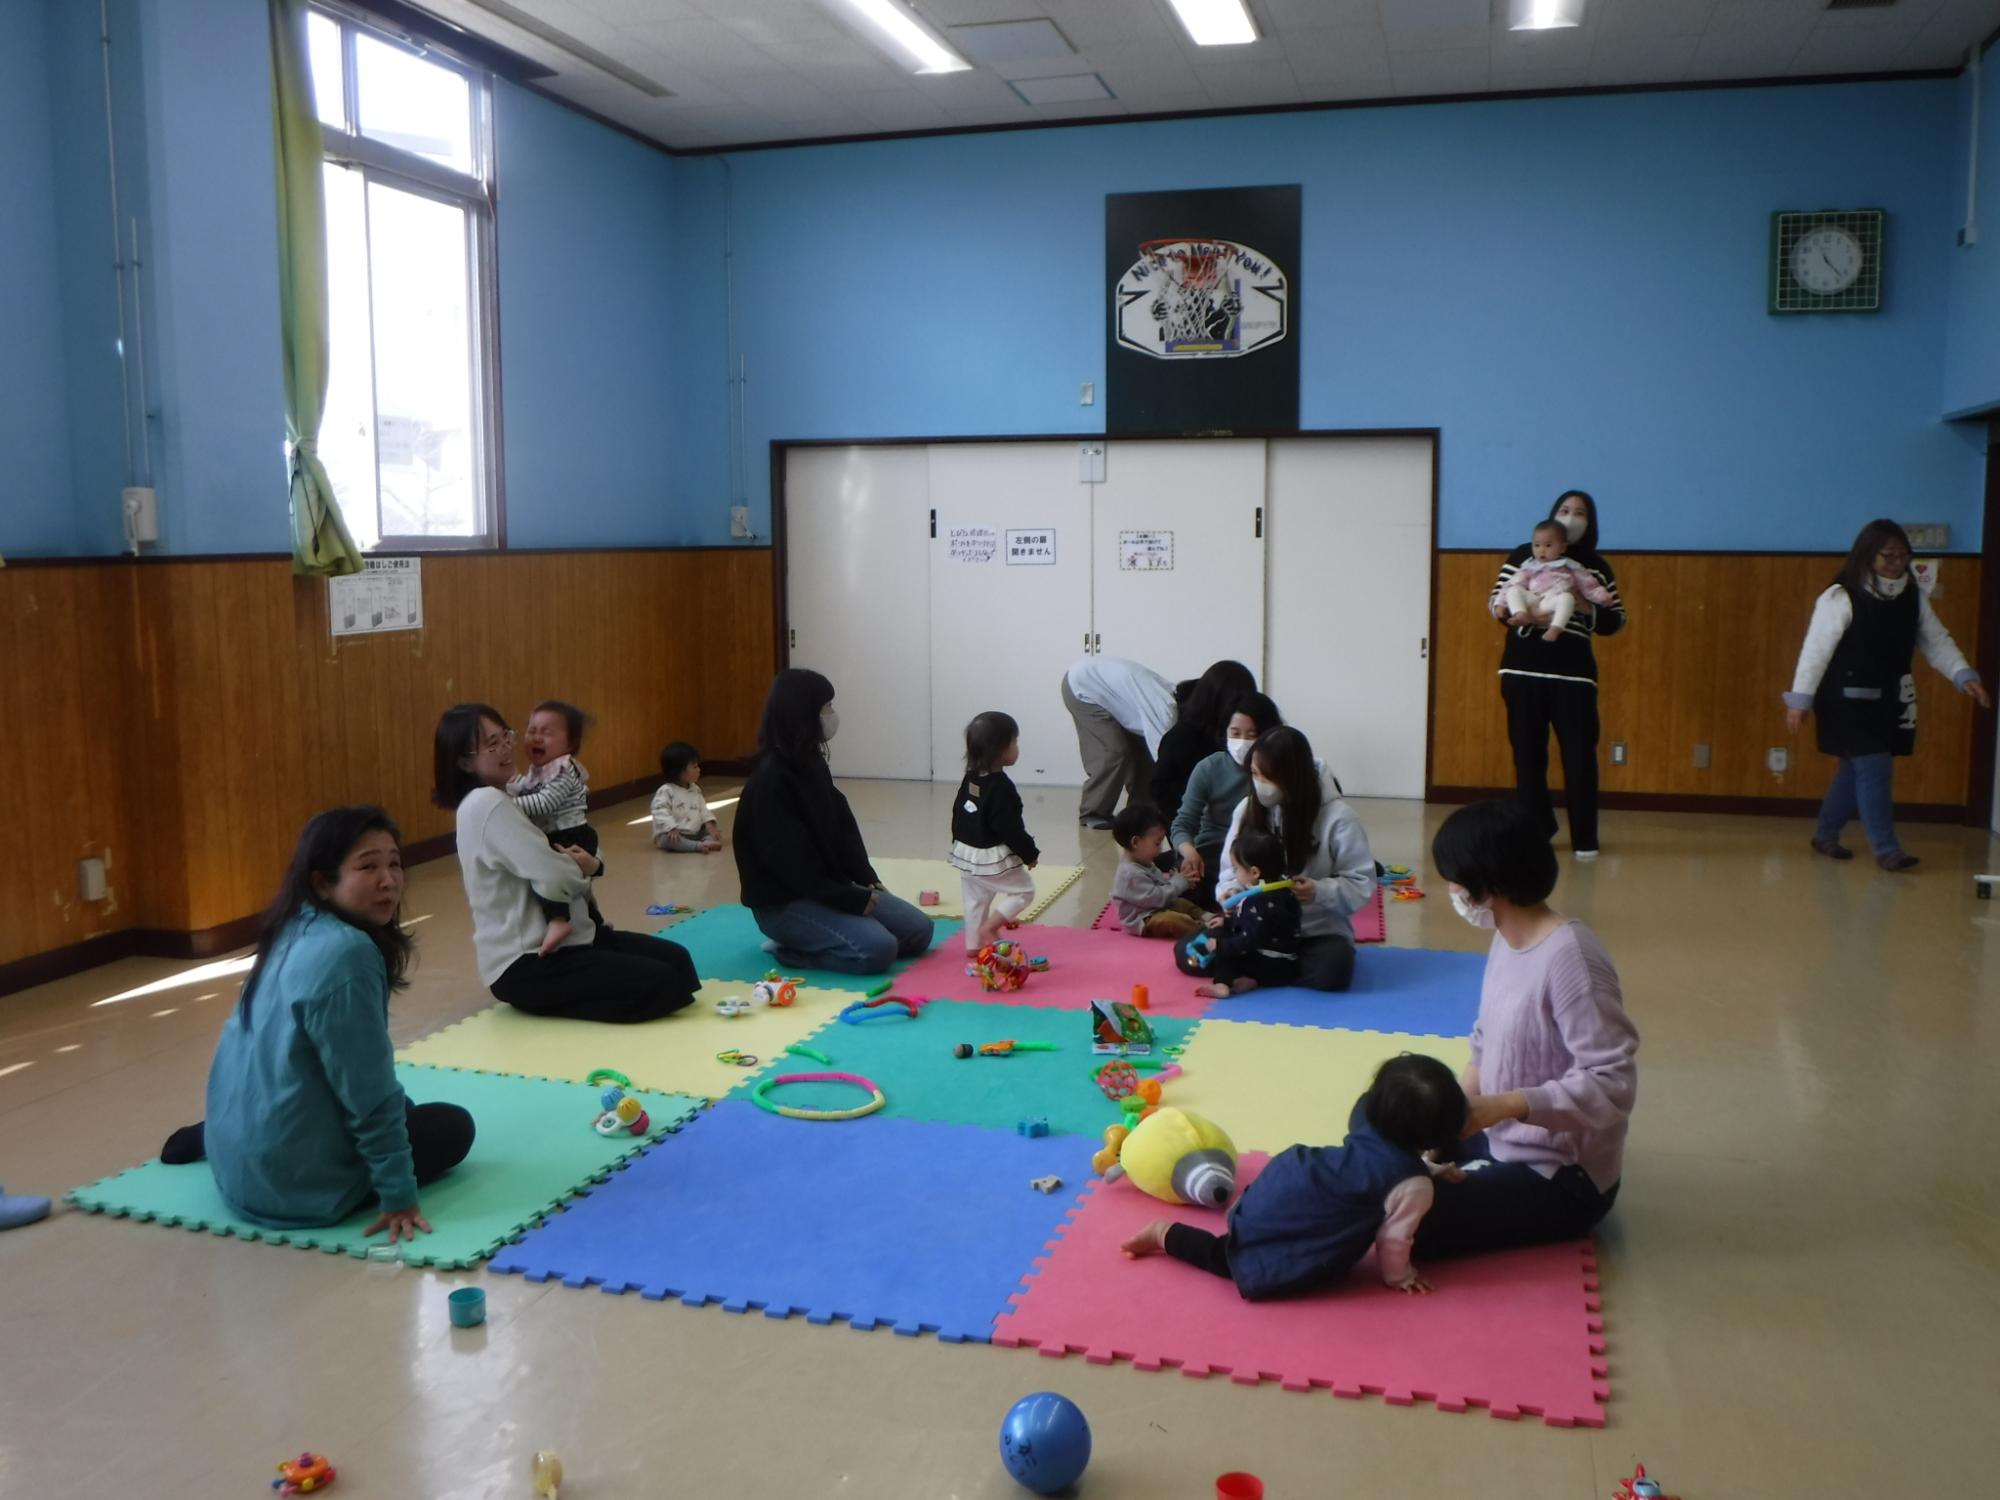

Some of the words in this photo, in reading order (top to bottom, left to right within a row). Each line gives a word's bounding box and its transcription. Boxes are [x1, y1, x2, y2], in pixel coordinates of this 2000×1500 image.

[1015, 536, 1047, 544] 左側の扉
[1011, 547, 1051, 556] 開きません
